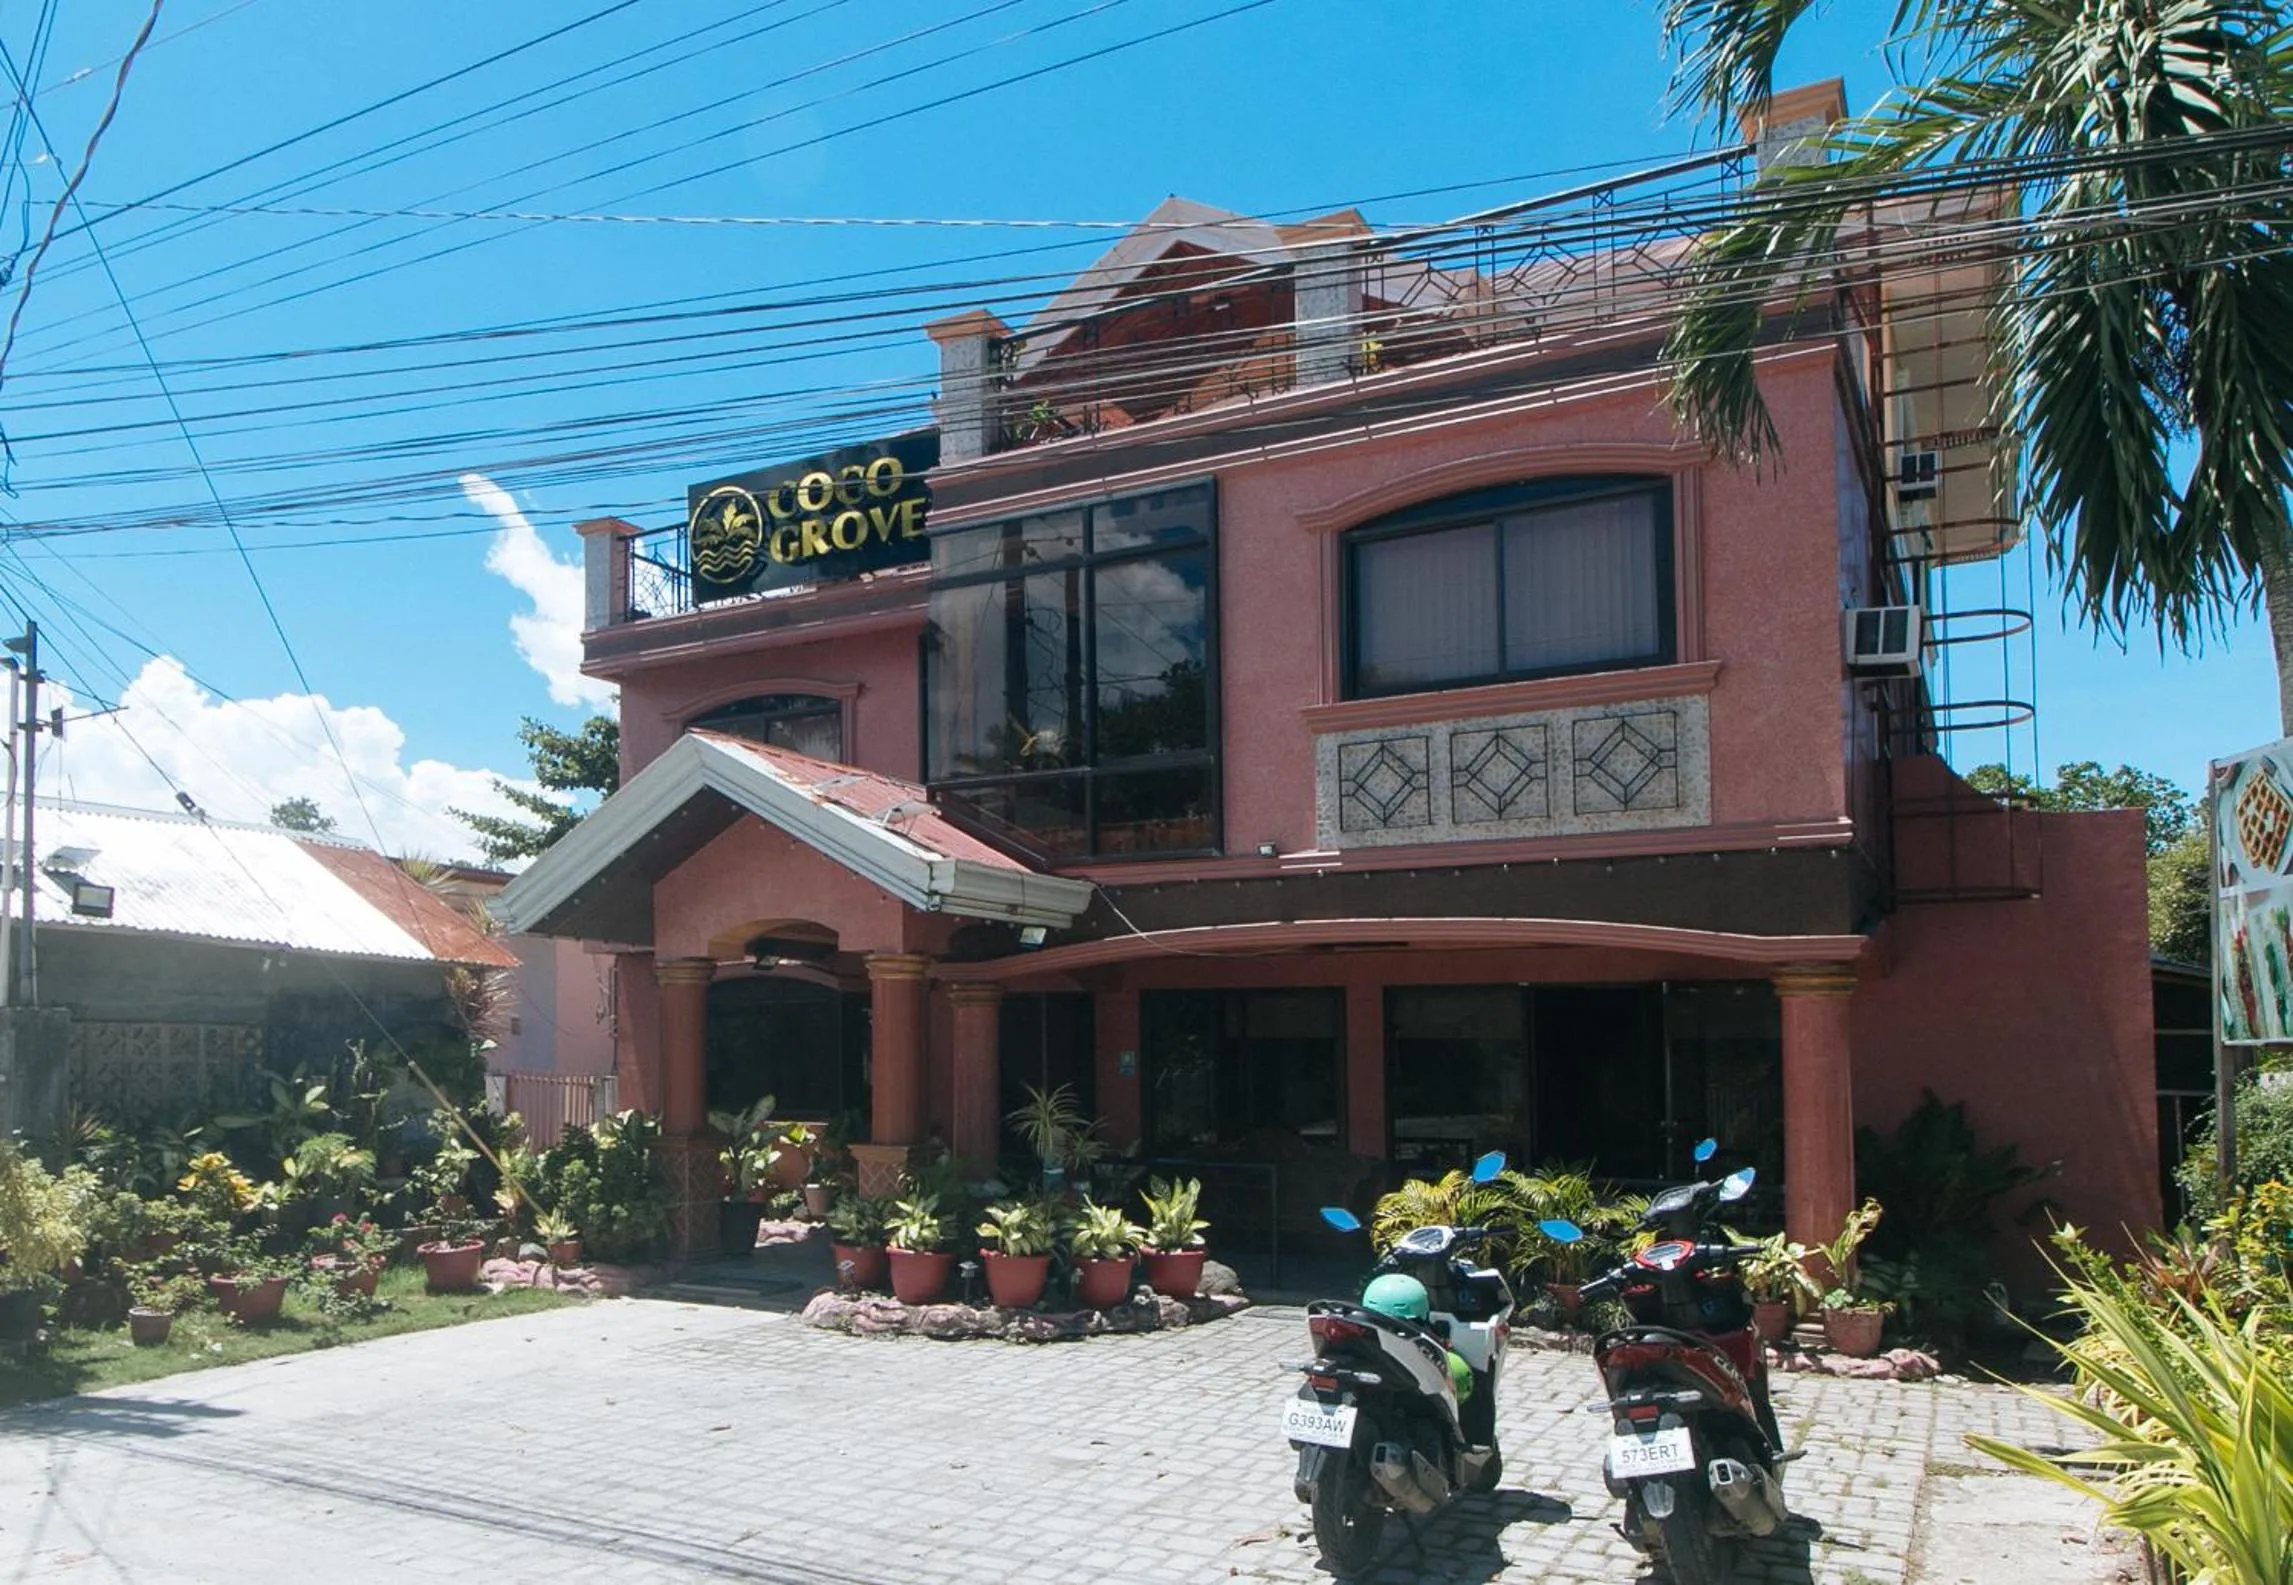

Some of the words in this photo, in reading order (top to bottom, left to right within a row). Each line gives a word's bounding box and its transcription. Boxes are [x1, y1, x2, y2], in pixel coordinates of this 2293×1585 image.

[767, 456, 904, 519] COCO
[769, 497, 926, 564] GROVE
[1621, 1443, 1679, 1464] 573ERT
